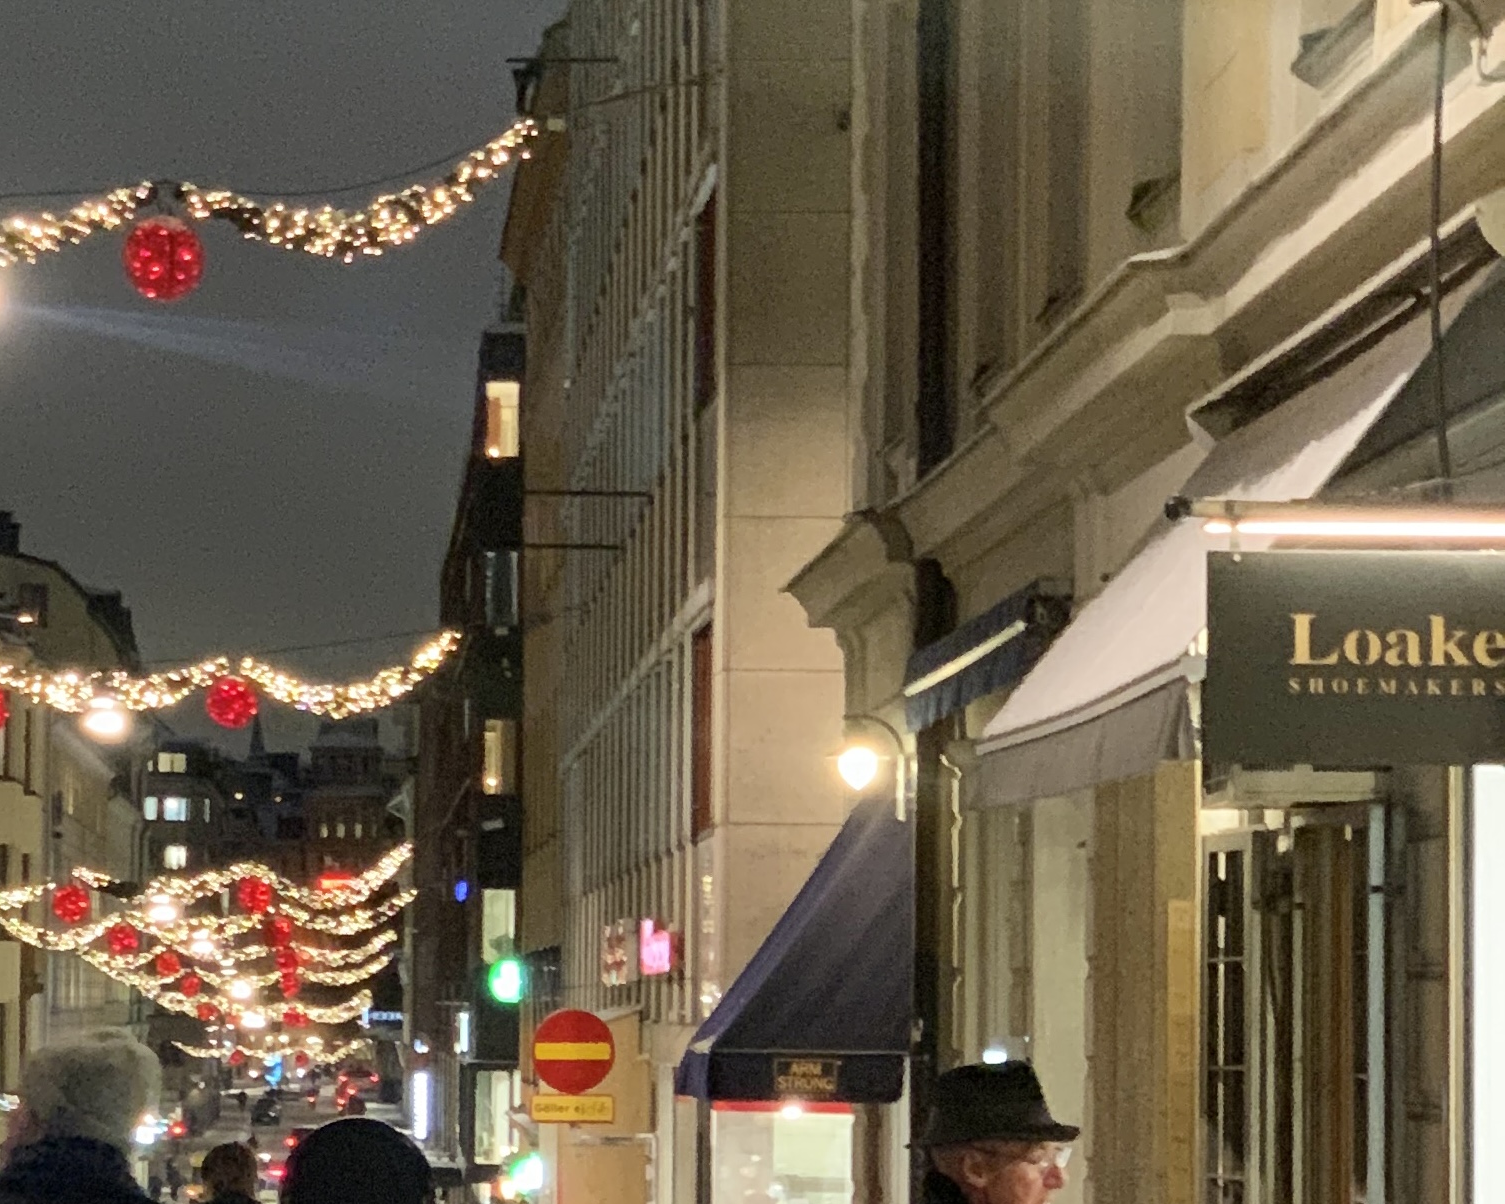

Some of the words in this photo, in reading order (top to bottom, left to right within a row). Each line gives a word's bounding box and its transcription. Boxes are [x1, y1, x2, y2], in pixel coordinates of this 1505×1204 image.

[1289, 611, 1505, 667] Loake
[1288, 677, 1505, 696] SHOEMAKERS
[777, 1075, 834, 1090] STRONG
